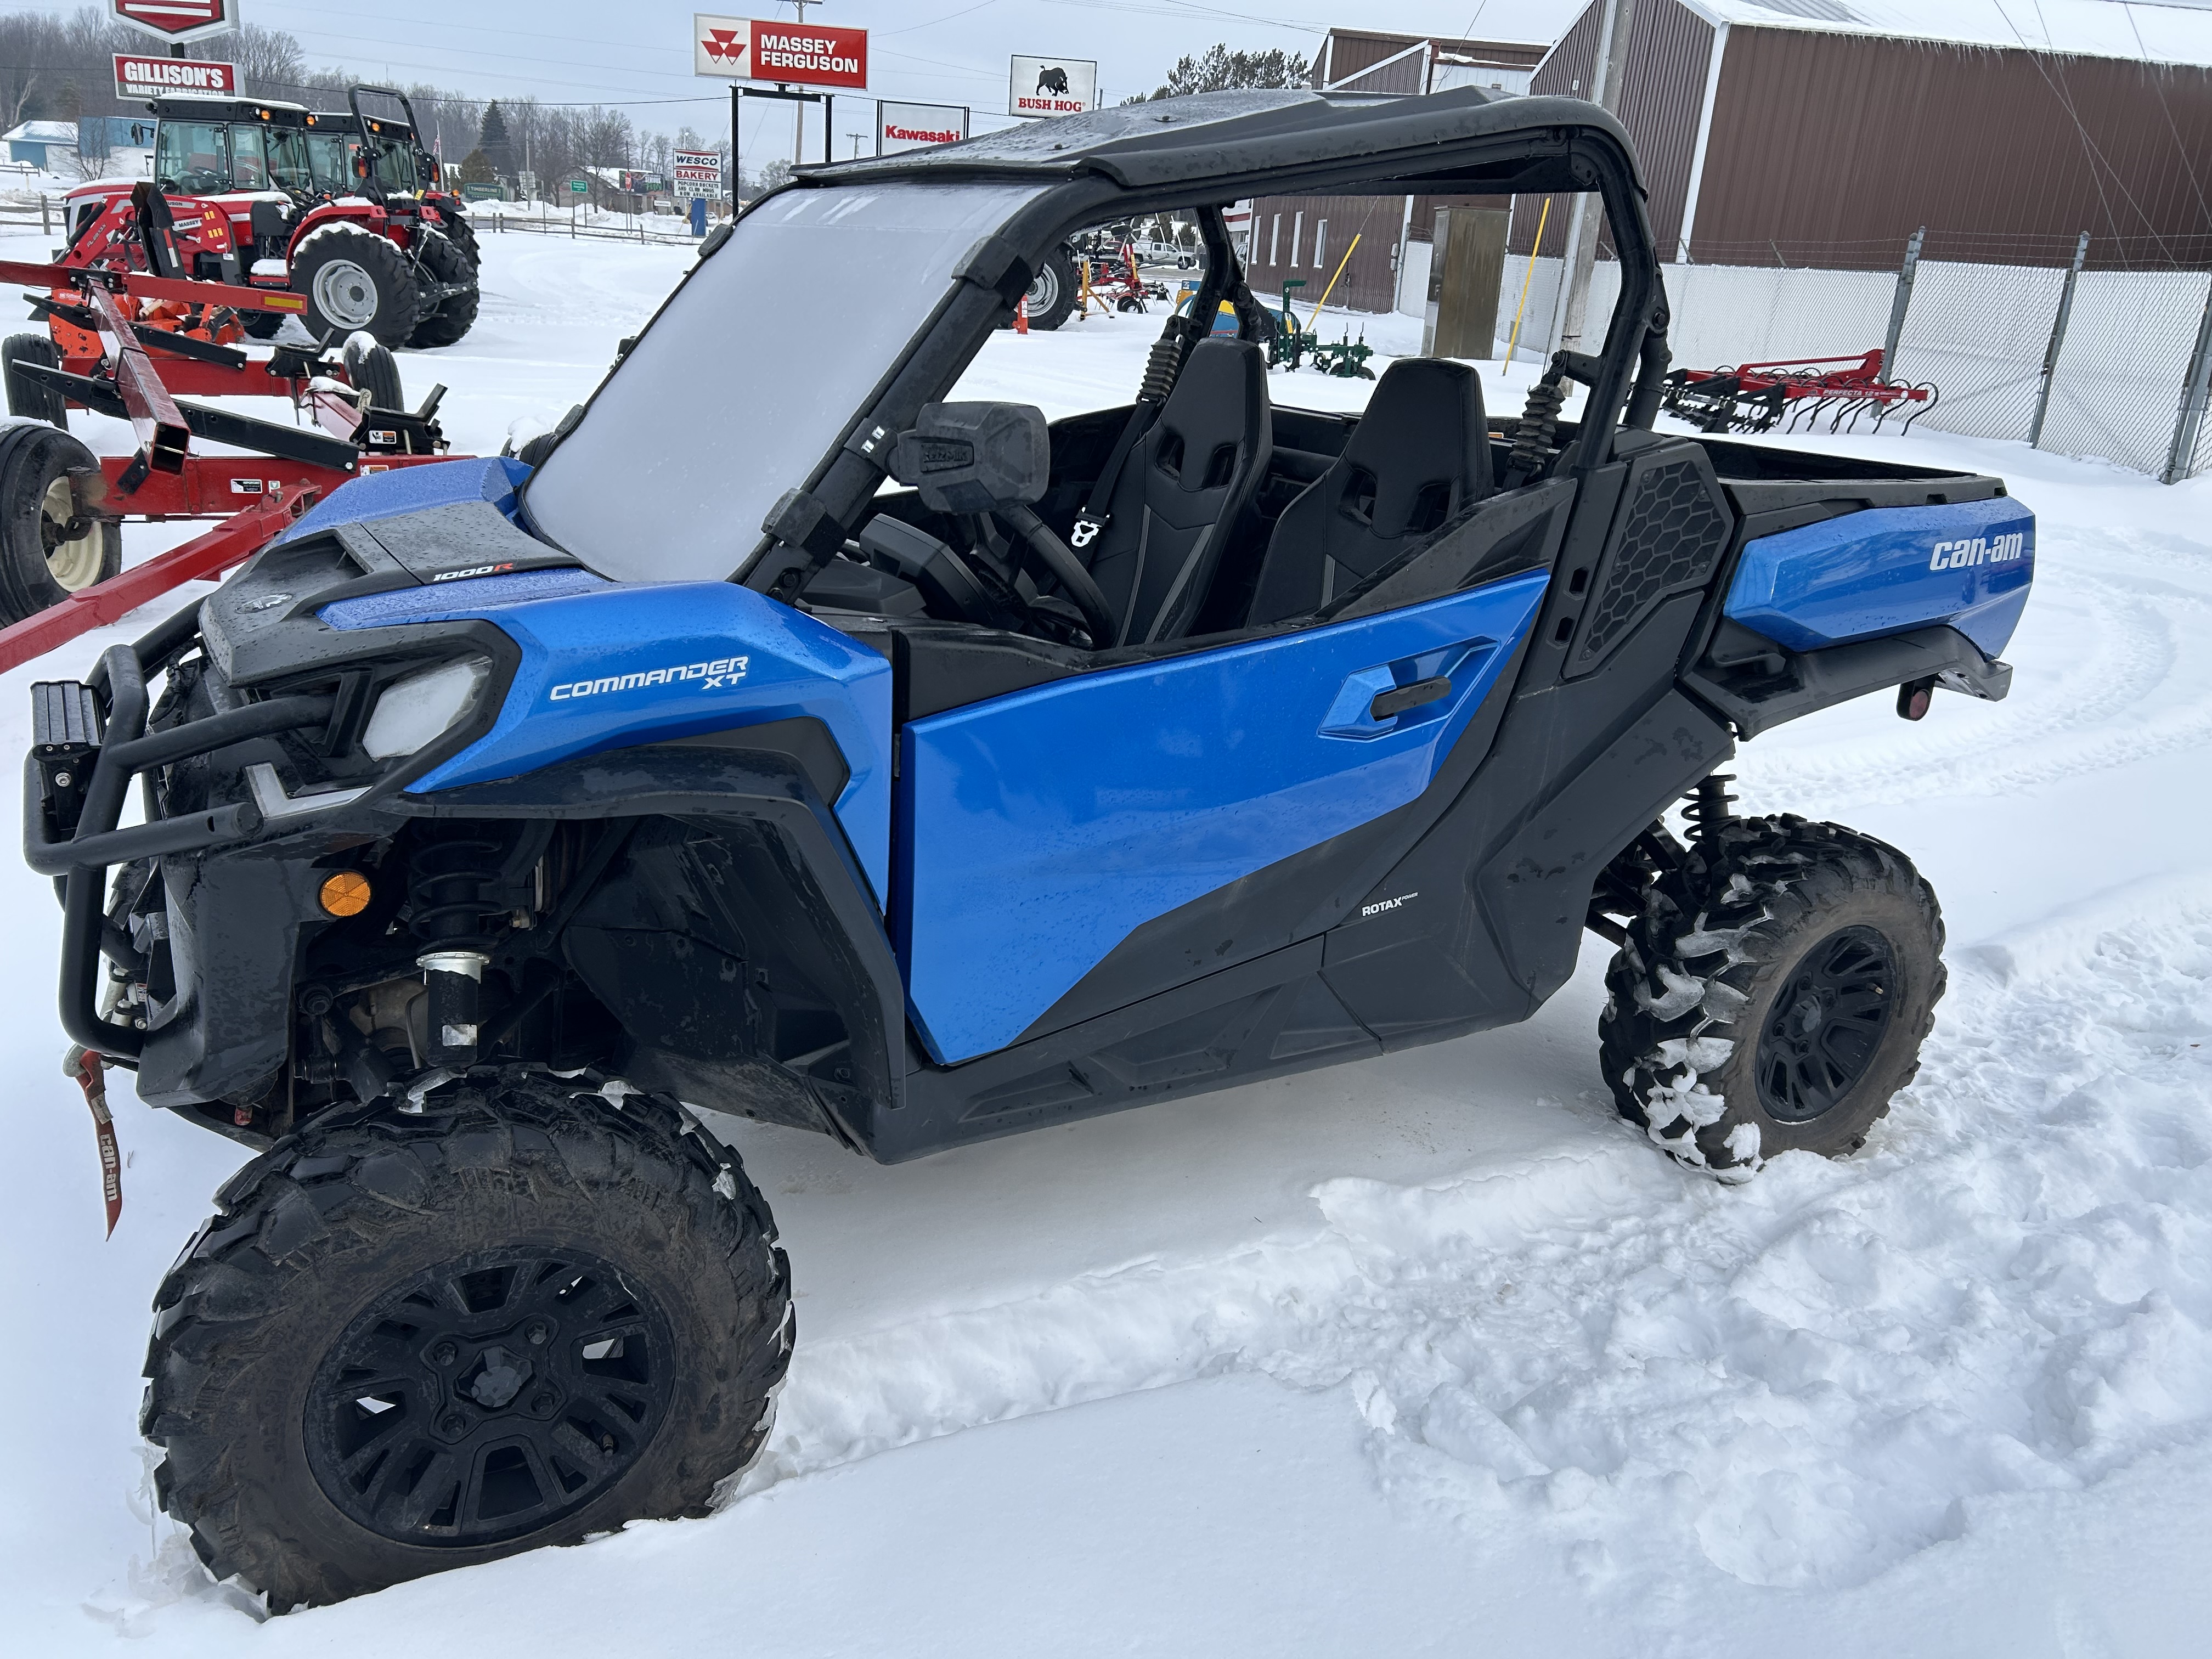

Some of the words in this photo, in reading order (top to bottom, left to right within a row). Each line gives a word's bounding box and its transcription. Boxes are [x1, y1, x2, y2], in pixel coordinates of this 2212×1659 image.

[760, 33, 837, 55] MASSEY
[760, 50, 858, 74] FERGUSON
[123, 61, 224, 88] GILLISON'S
[126, 83, 163, 95] VARIETY
[1018, 97, 1052, 110] BUSH
[885, 125, 960, 143] Kawasaki
[676, 155, 718, 166] WESCO
[676, 170, 719, 181] BAKERY
[178, 219, 199, 228] MASSEY
[1929, 532, 2023, 572] can-am
[433, 562, 514, 582] 1000R
[549, 656, 749, 701] COMMANDER
[701, 672, 746, 690] XT
[1362, 896, 1403, 917] ROTAX
[1401, 892, 1418, 901] POWER
[99, 1133, 118, 1202] can-am
